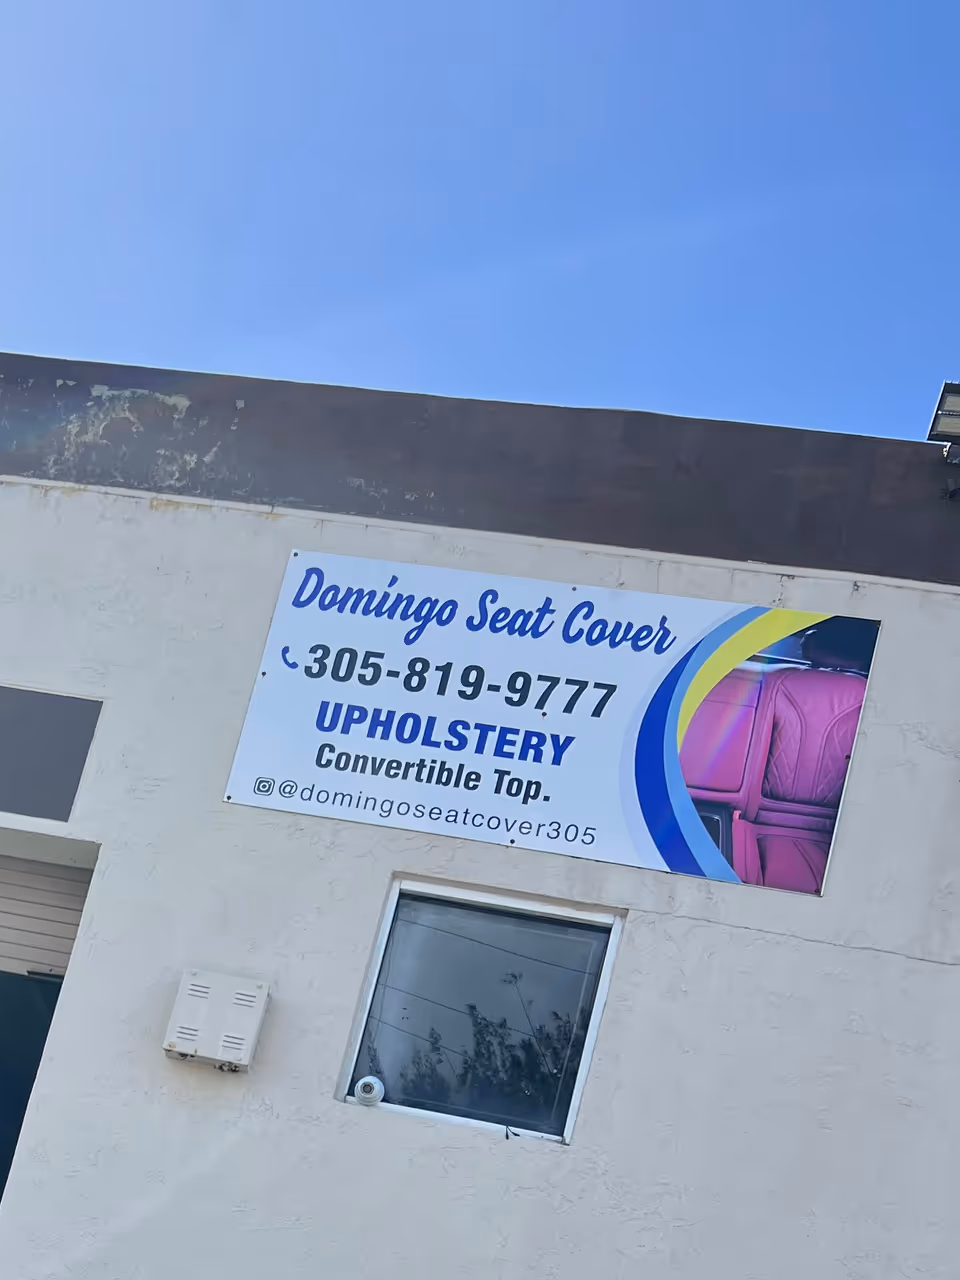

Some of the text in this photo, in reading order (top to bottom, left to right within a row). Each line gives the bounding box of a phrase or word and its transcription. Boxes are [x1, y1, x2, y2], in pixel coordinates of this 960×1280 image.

[291, 566, 677, 656] Domingo Seat Cover
[303, 643, 618, 719] 305-819-9777
[315, 700, 576, 767] UPHOLSTERY
[315, 742, 551, 805] Convertible Top.
[278, 778, 598, 846] @domingoseatcover305
